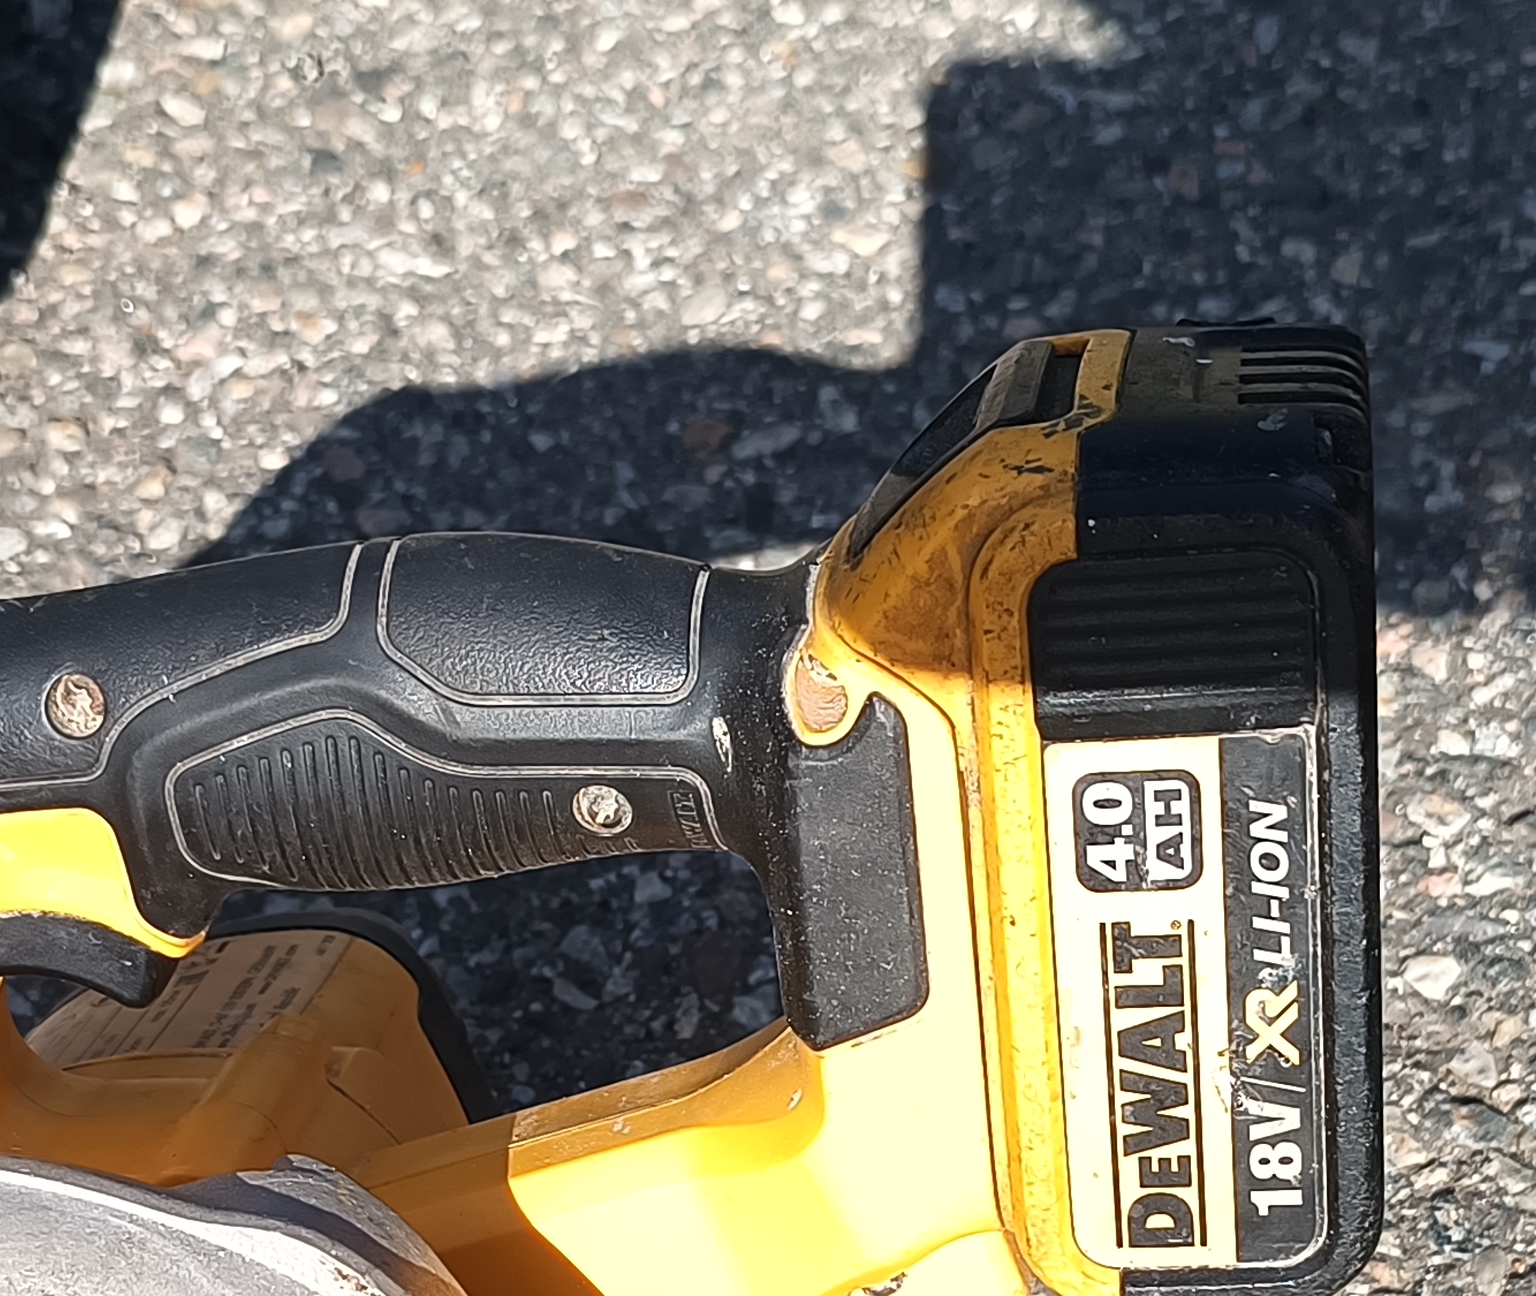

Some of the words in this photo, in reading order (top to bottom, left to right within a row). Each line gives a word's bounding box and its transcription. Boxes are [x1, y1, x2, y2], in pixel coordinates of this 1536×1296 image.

[1082, 780, 1134, 884] 4.0
[1149, 787, 1187, 869] AH
[1248, 798, 1292, 965] LI-ION
[1112, 920, 1195, 1248] DEWALT
[1246, 1099, 1305, 1217] 18V
